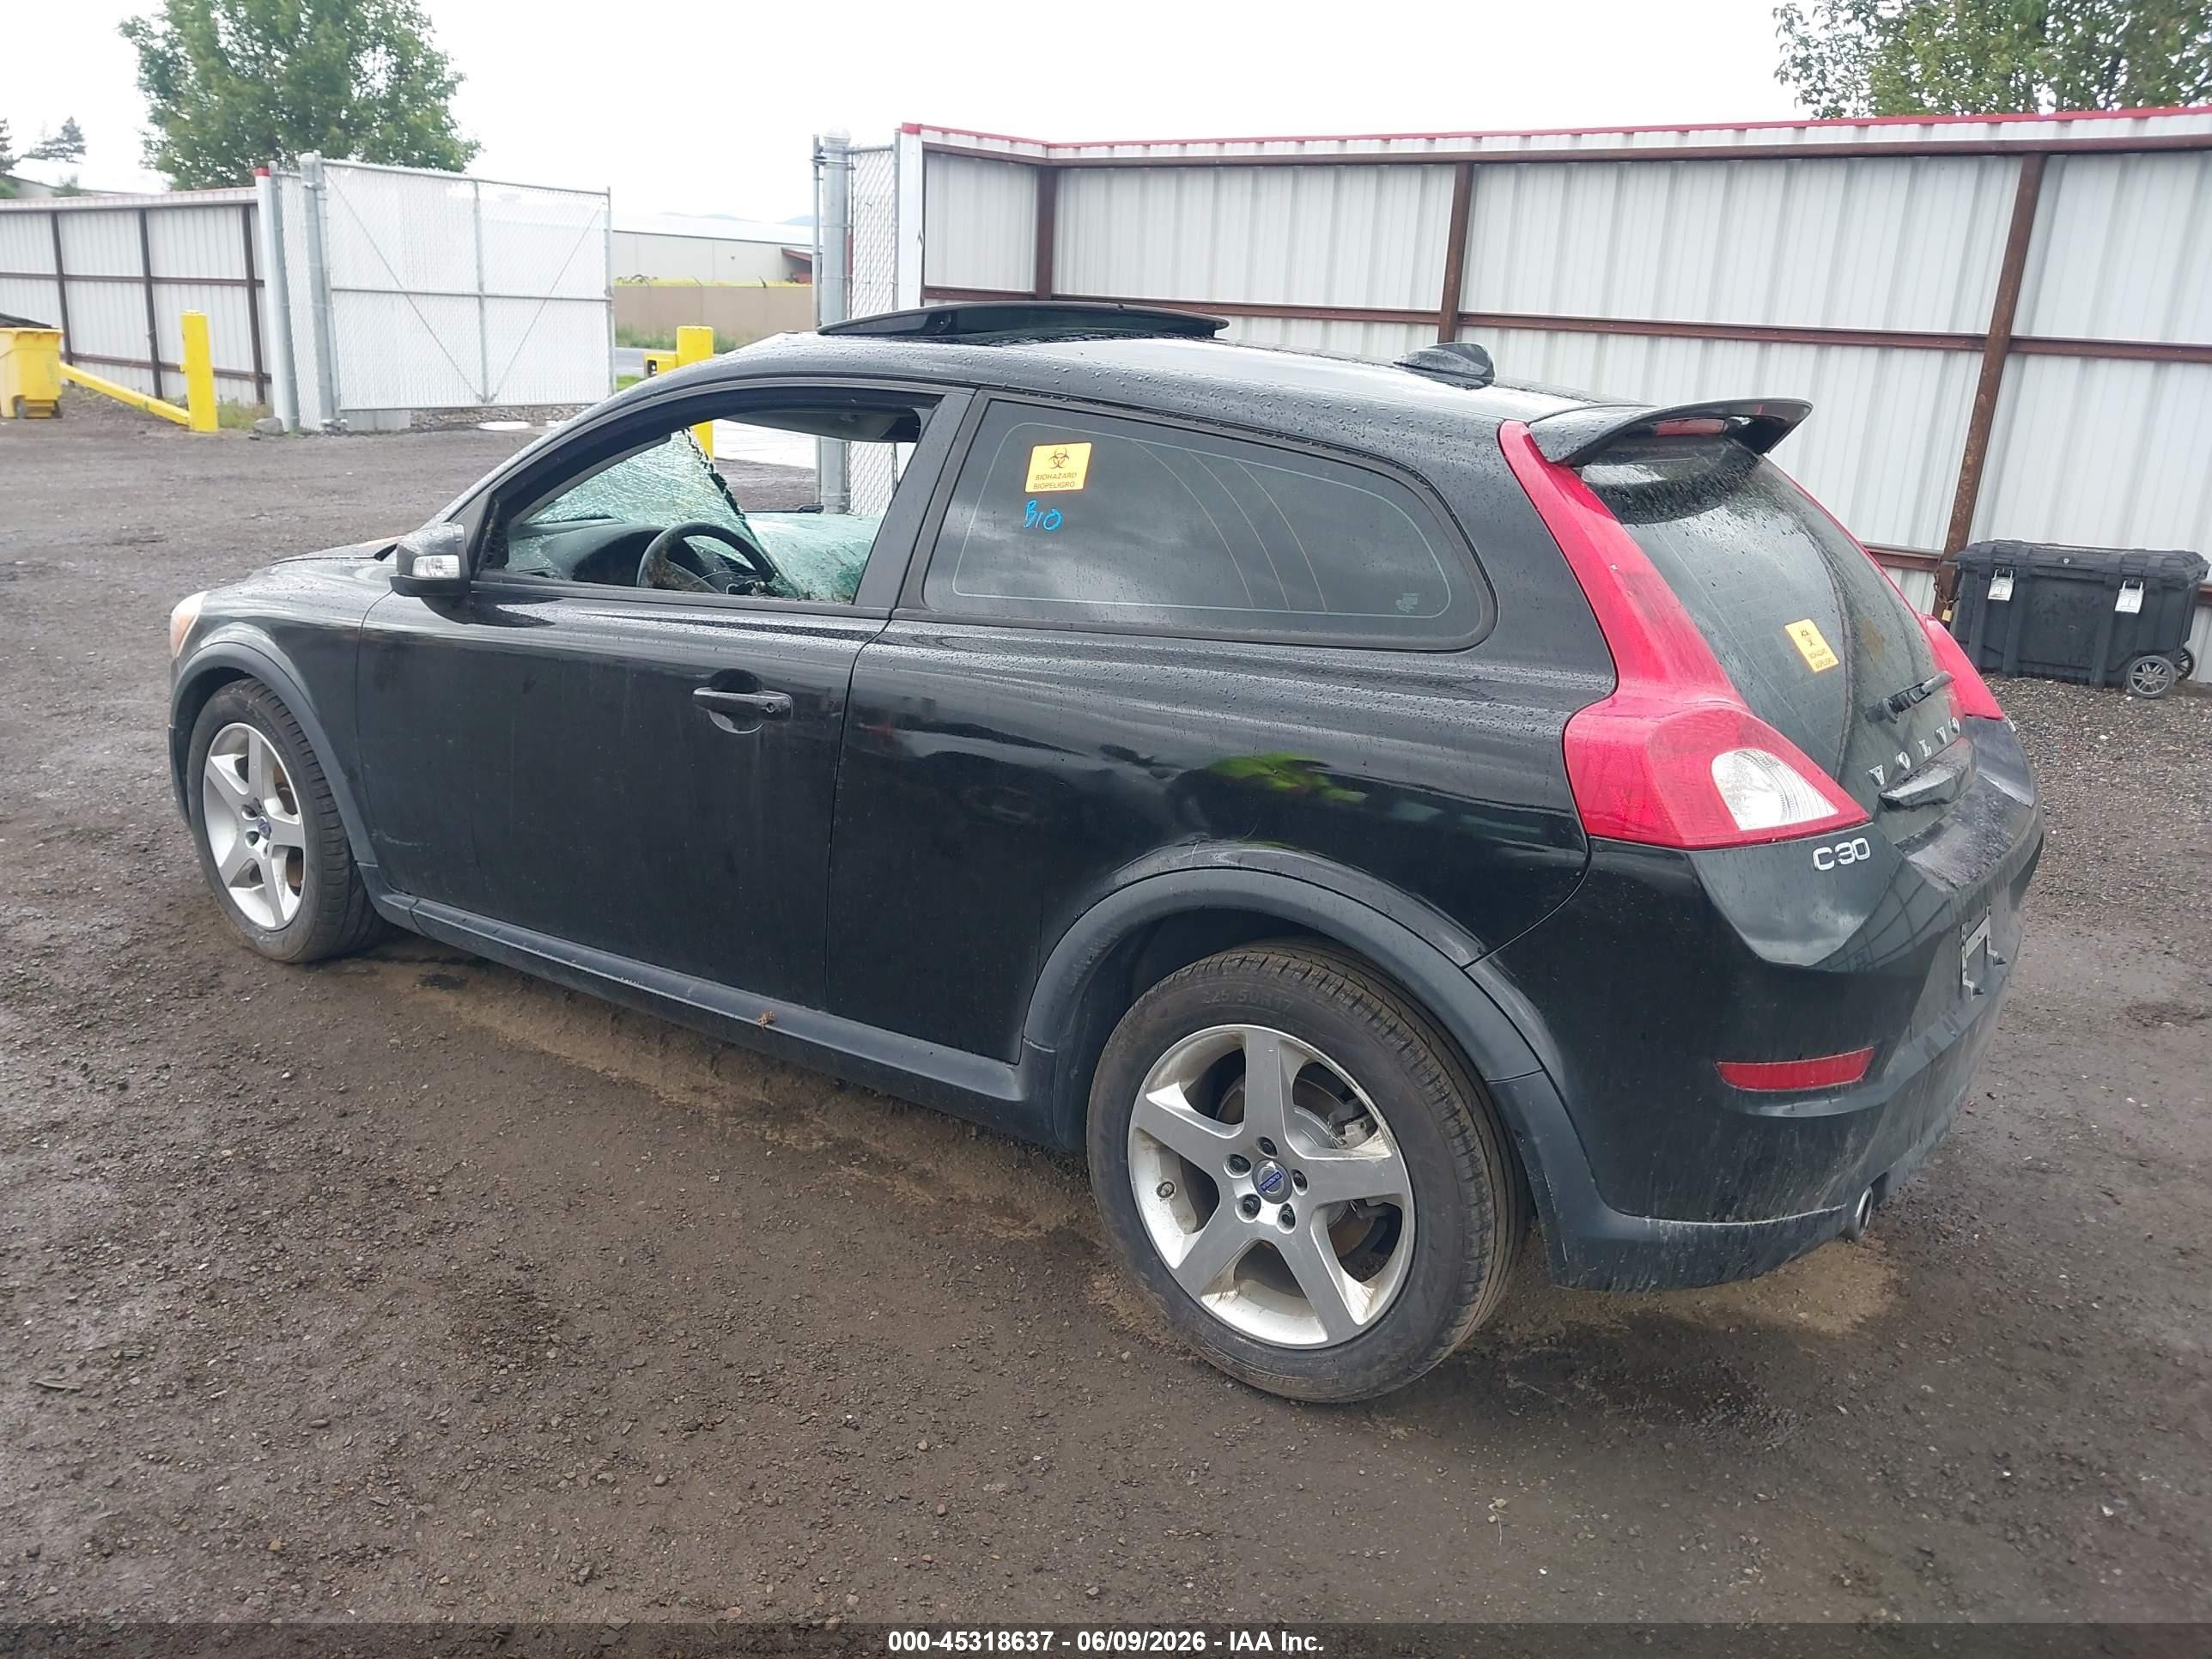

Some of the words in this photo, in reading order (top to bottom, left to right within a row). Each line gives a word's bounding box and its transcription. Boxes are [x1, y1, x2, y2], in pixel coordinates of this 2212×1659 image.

[1033, 481, 1075, 489] BIOPELIGRO
[1035, 471, 1078, 481] BIOHAZARD
[1024, 499, 1063, 530] BIO
[1867, 716, 1961, 786] VOLVO
[1813, 837, 1871, 871] C30
